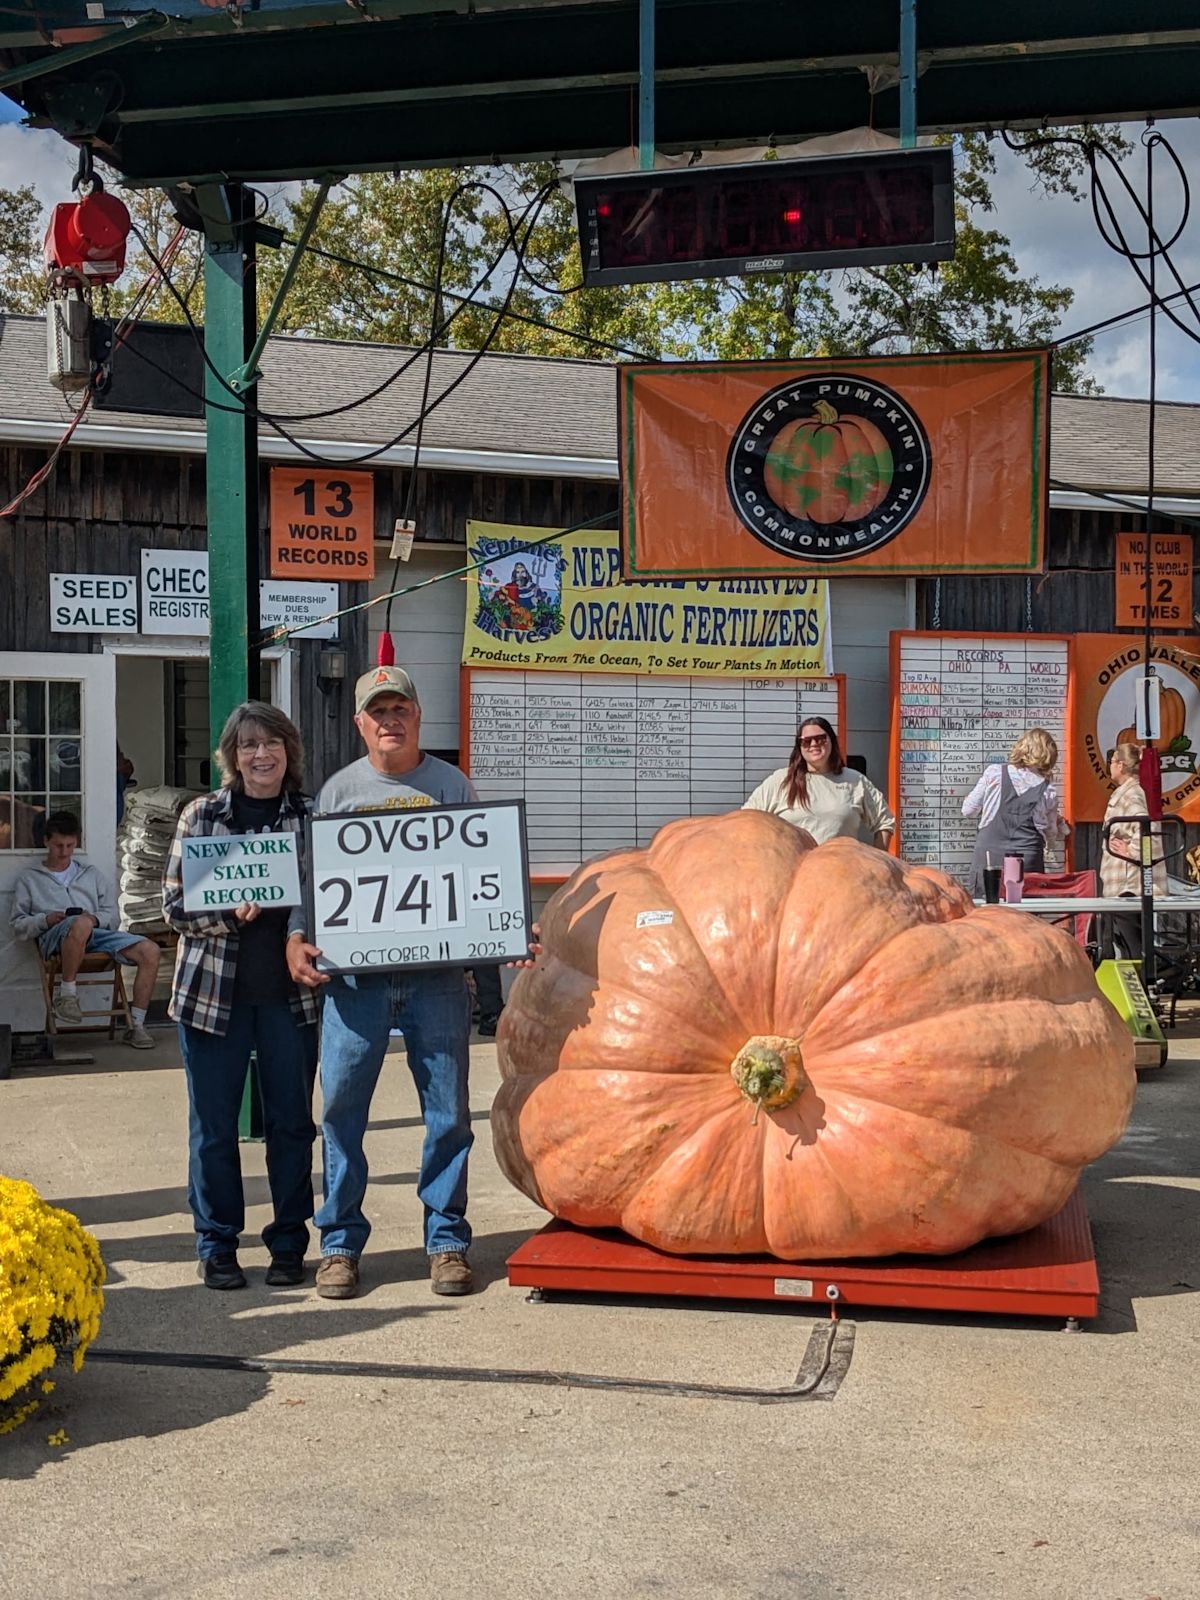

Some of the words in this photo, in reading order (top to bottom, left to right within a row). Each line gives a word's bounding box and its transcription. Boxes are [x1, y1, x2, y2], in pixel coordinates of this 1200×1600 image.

[744, 390, 801, 452] GREAT
[818, 384, 916, 450] PUMPKIN
[294, 478, 353, 518] 13
[744, 488, 912, 548] COMMONWEALTH
[288, 524, 357, 542] WORLD
[278, 548, 368, 566] RECORDS
[1155, 542, 1180, 554] CLUB
[1120, 562, 1130, 575] IN
[1133, 562, 1154, 575] THE
[1156, 562, 1188, 576] WORLD
[62, 580, 128, 599] SEED
[146, 567, 206, 594] CHEC
[268, 594, 327, 604] MEMBERSHIP
[56, 606, 136, 627] SALES
[150, 601, 208, 618] REGISTR
[261, 614, 281, 622] NEW
[284, 614, 290, 622] &
[286, 605, 309, 613] DUES
[1130, 606, 1180, 619] TIMES
[570, 600, 674, 643] ORGANIC
[682, 605, 820, 647] FERTILIZERS
[470, 647, 530, 662] Products
[535, 652, 568, 664] From
[572, 653, 595, 664] The
[600, 653, 642, 668] Ocean,
[648, 656, 662, 667] To
[666, 656, 688, 668] Set
[692, 658, 721, 670] Your
[722, 659, 762, 671] Plants
[764, 660, 777, 670] In
[780, 659, 821, 670] Motion
[957, 650, 1004, 662] RECORDS
[948, 660, 972, 673] OHIO
[999, 662, 1011, 673] PA
[1029, 662, 1060, 675] WORLD
[1098, 648, 1140, 686] OHIO
[1148, 647, 1200, 680] VALLE
[748, 680, 770, 690] TOP
[1085, 734, 1107, 780] GIANT
[1175, 778, 1200, 801] GRO
[337, 813, 488, 854] OVGPG
[186, 842, 231, 859] NEW
[238, 838, 292, 856] YORK
[214, 864, 270, 880] STATE
[203, 886, 284, 905] RECORD
[319, 872, 500, 928] 2741.5
[488, 910, 524, 931] LBS
[350, 945, 430, 966] OCTOBER
[439, 941, 450, 960] 11
[467, 941, 506, 958] 2025
